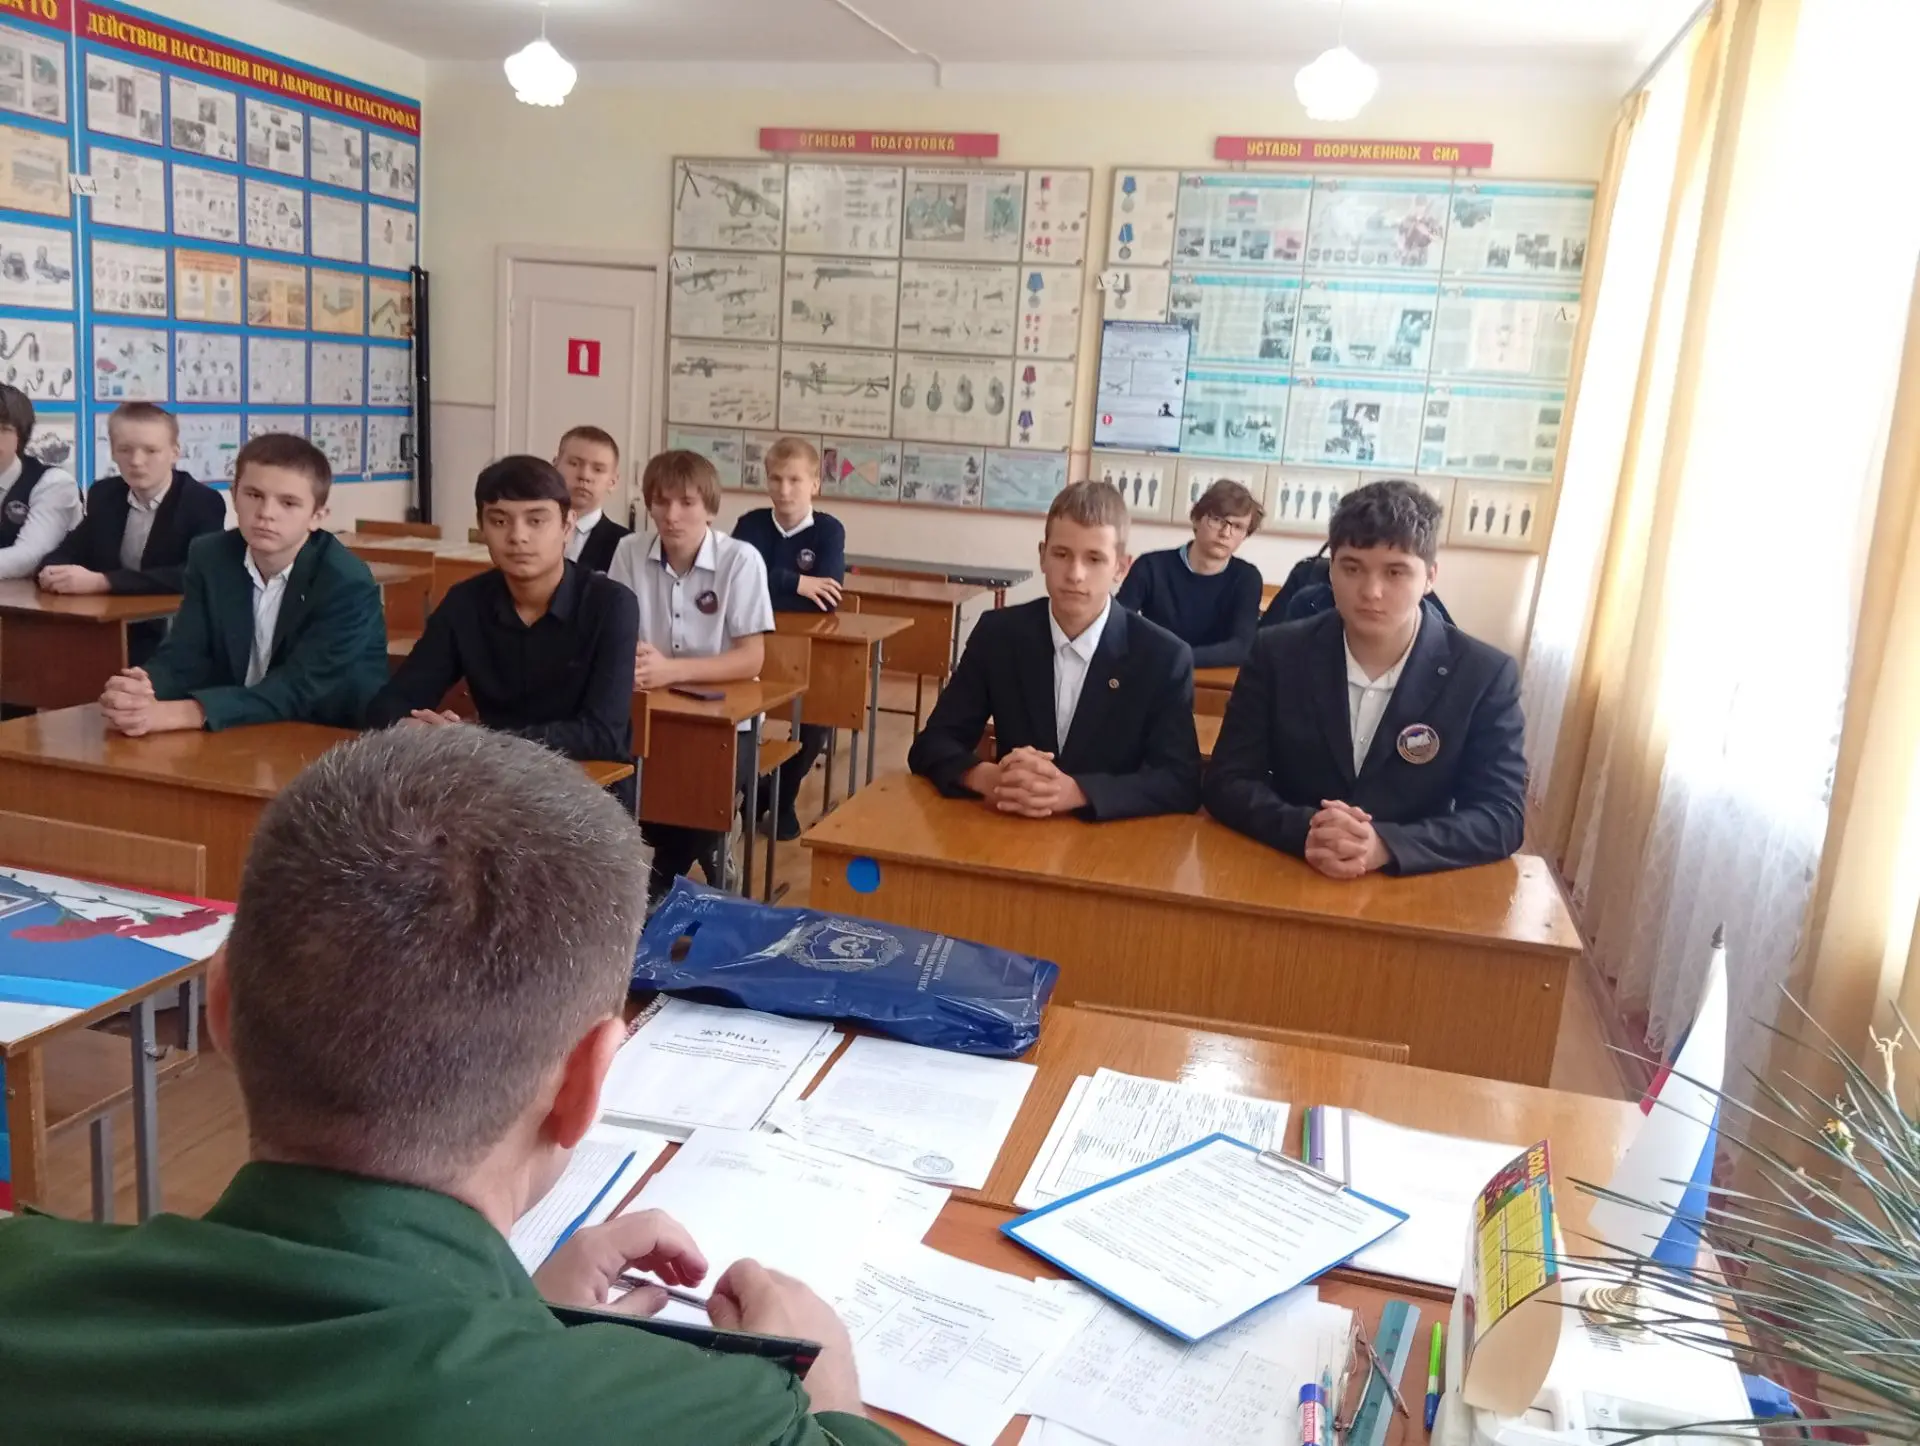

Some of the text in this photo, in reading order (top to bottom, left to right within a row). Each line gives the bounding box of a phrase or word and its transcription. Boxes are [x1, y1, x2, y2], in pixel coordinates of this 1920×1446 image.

[86, 11, 167, 53] ДЕЙСТВИЯ
[170, 37, 249, 78] НАСЕЛЕНИЯ
[252, 62, 278, 87] ПРИ
[280, 71, 332, 104] АВАРИЯХ
[334, 88, 343, 108] И
[345, 93, 417, 131] КАТАСТРОФАХ
[800, 132, 955, 151] ОГНЕВАЯ ПОДГОТОВКА
[1247, 140, 1460, 161] УСТАВЫ ВООРУЖЕННЫХ СИЛ
